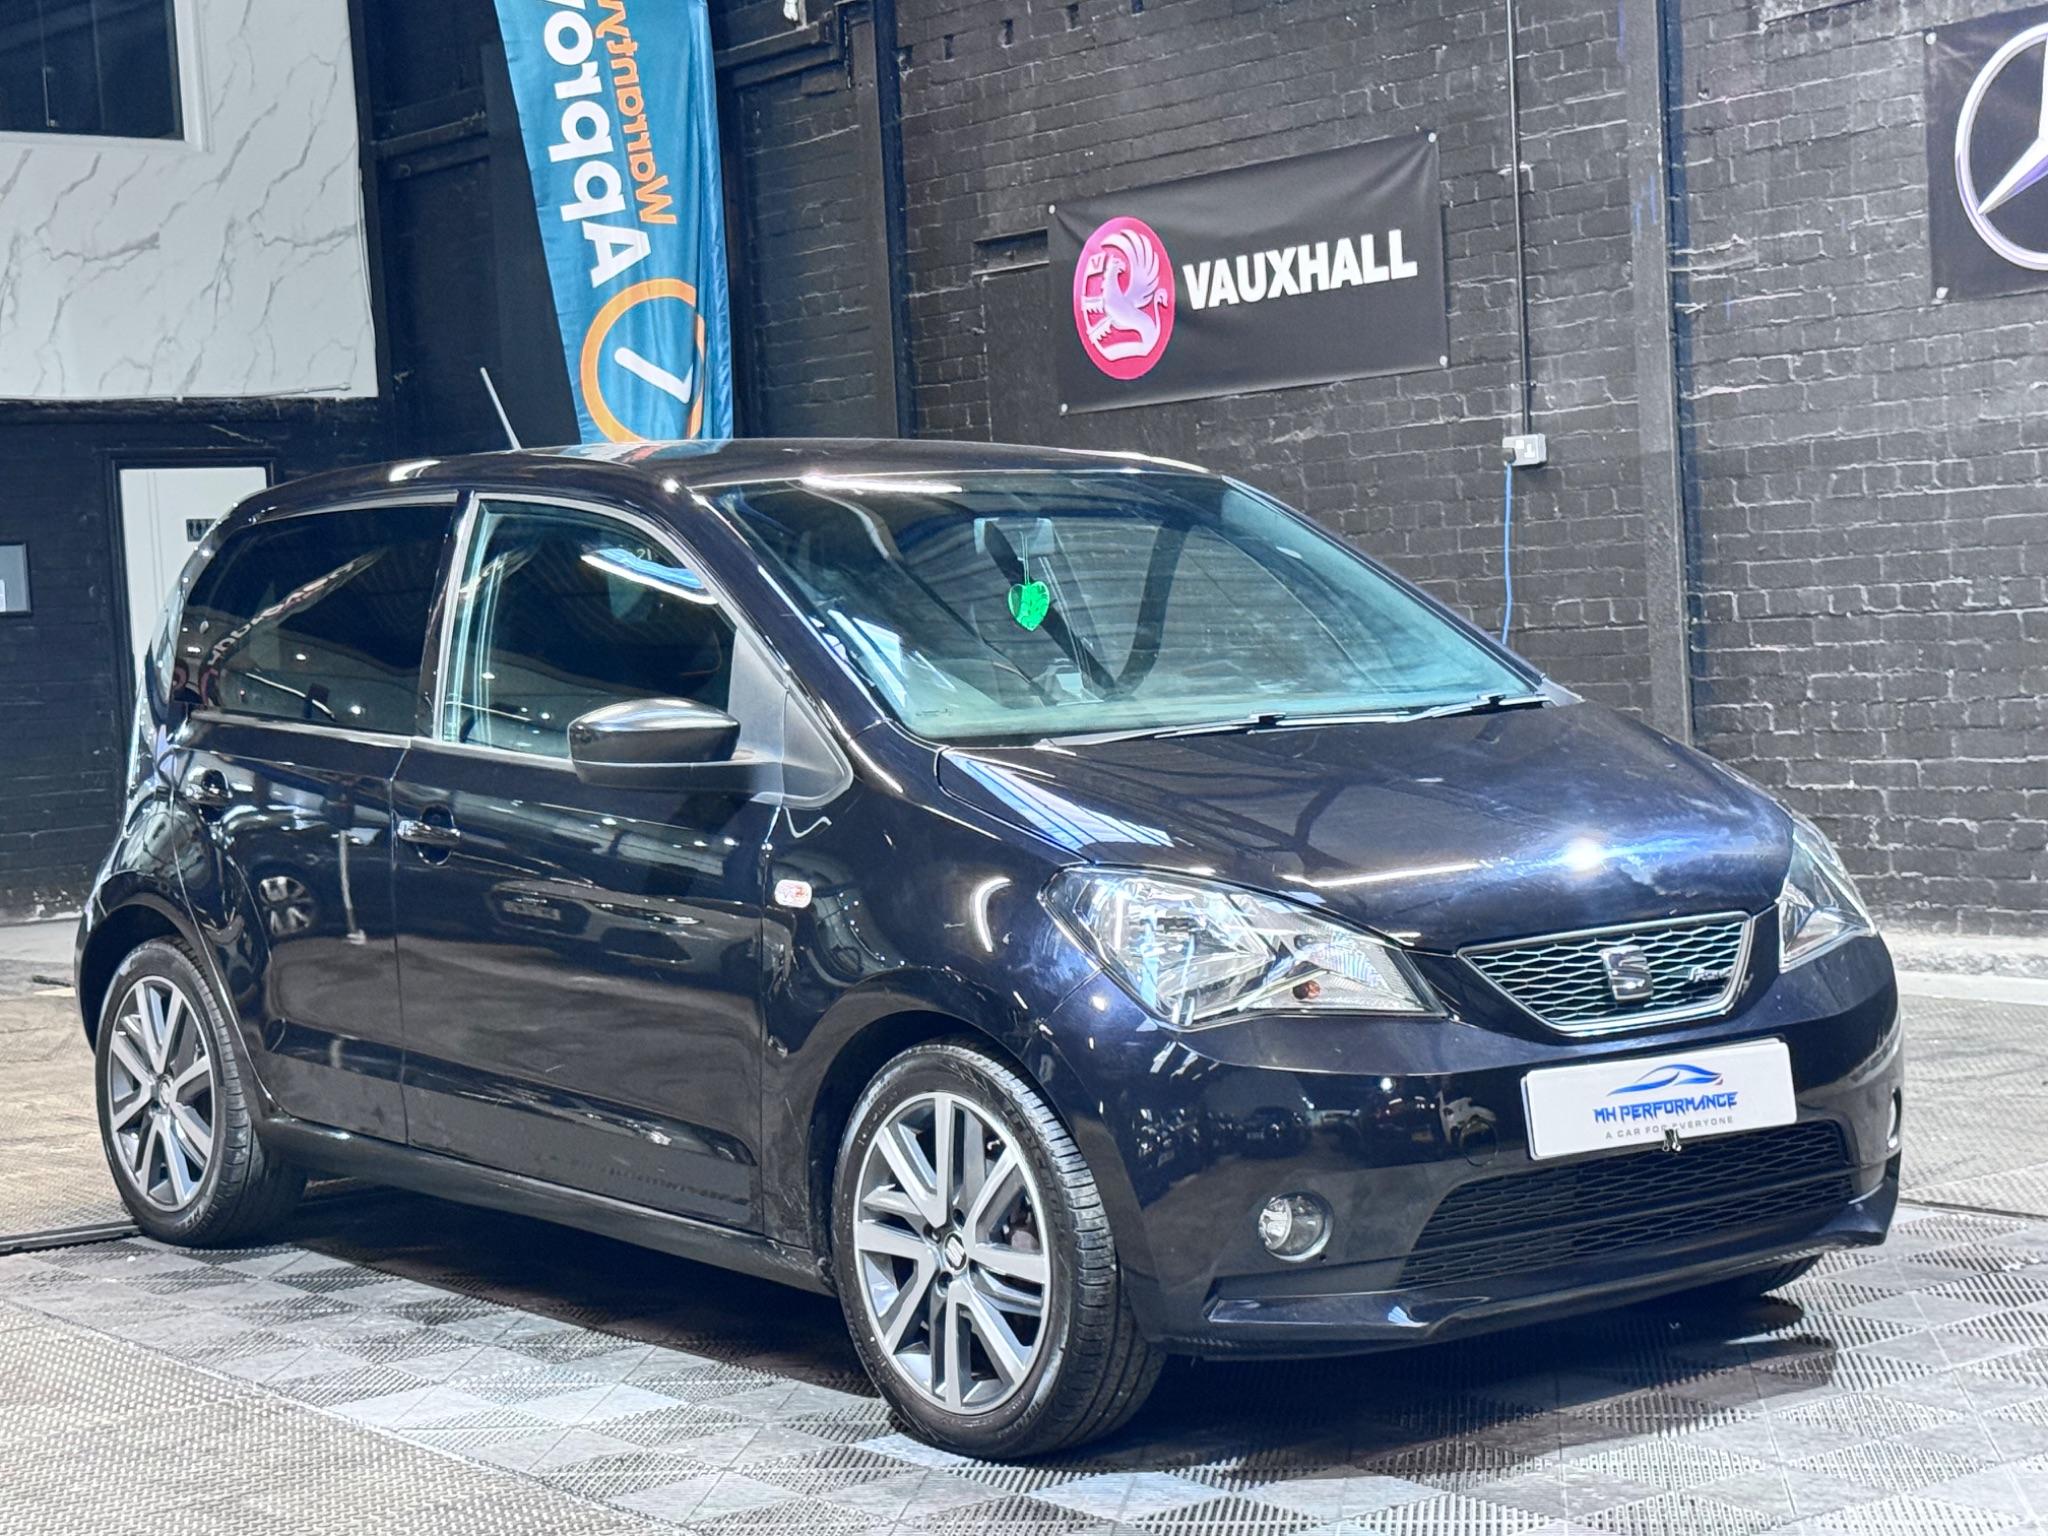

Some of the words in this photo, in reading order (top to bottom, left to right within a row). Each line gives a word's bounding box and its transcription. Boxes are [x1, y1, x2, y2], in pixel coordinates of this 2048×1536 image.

[1182, 229, 1418, 311] VAUXHALL
[1593, 1106, 1617, 1123] MH
[1618, 1091, 1738, 1124] PERFORMANCE
[1605, 1131, 1613, 1139] A
[1617, 1126, 1641, 1139] CAR
